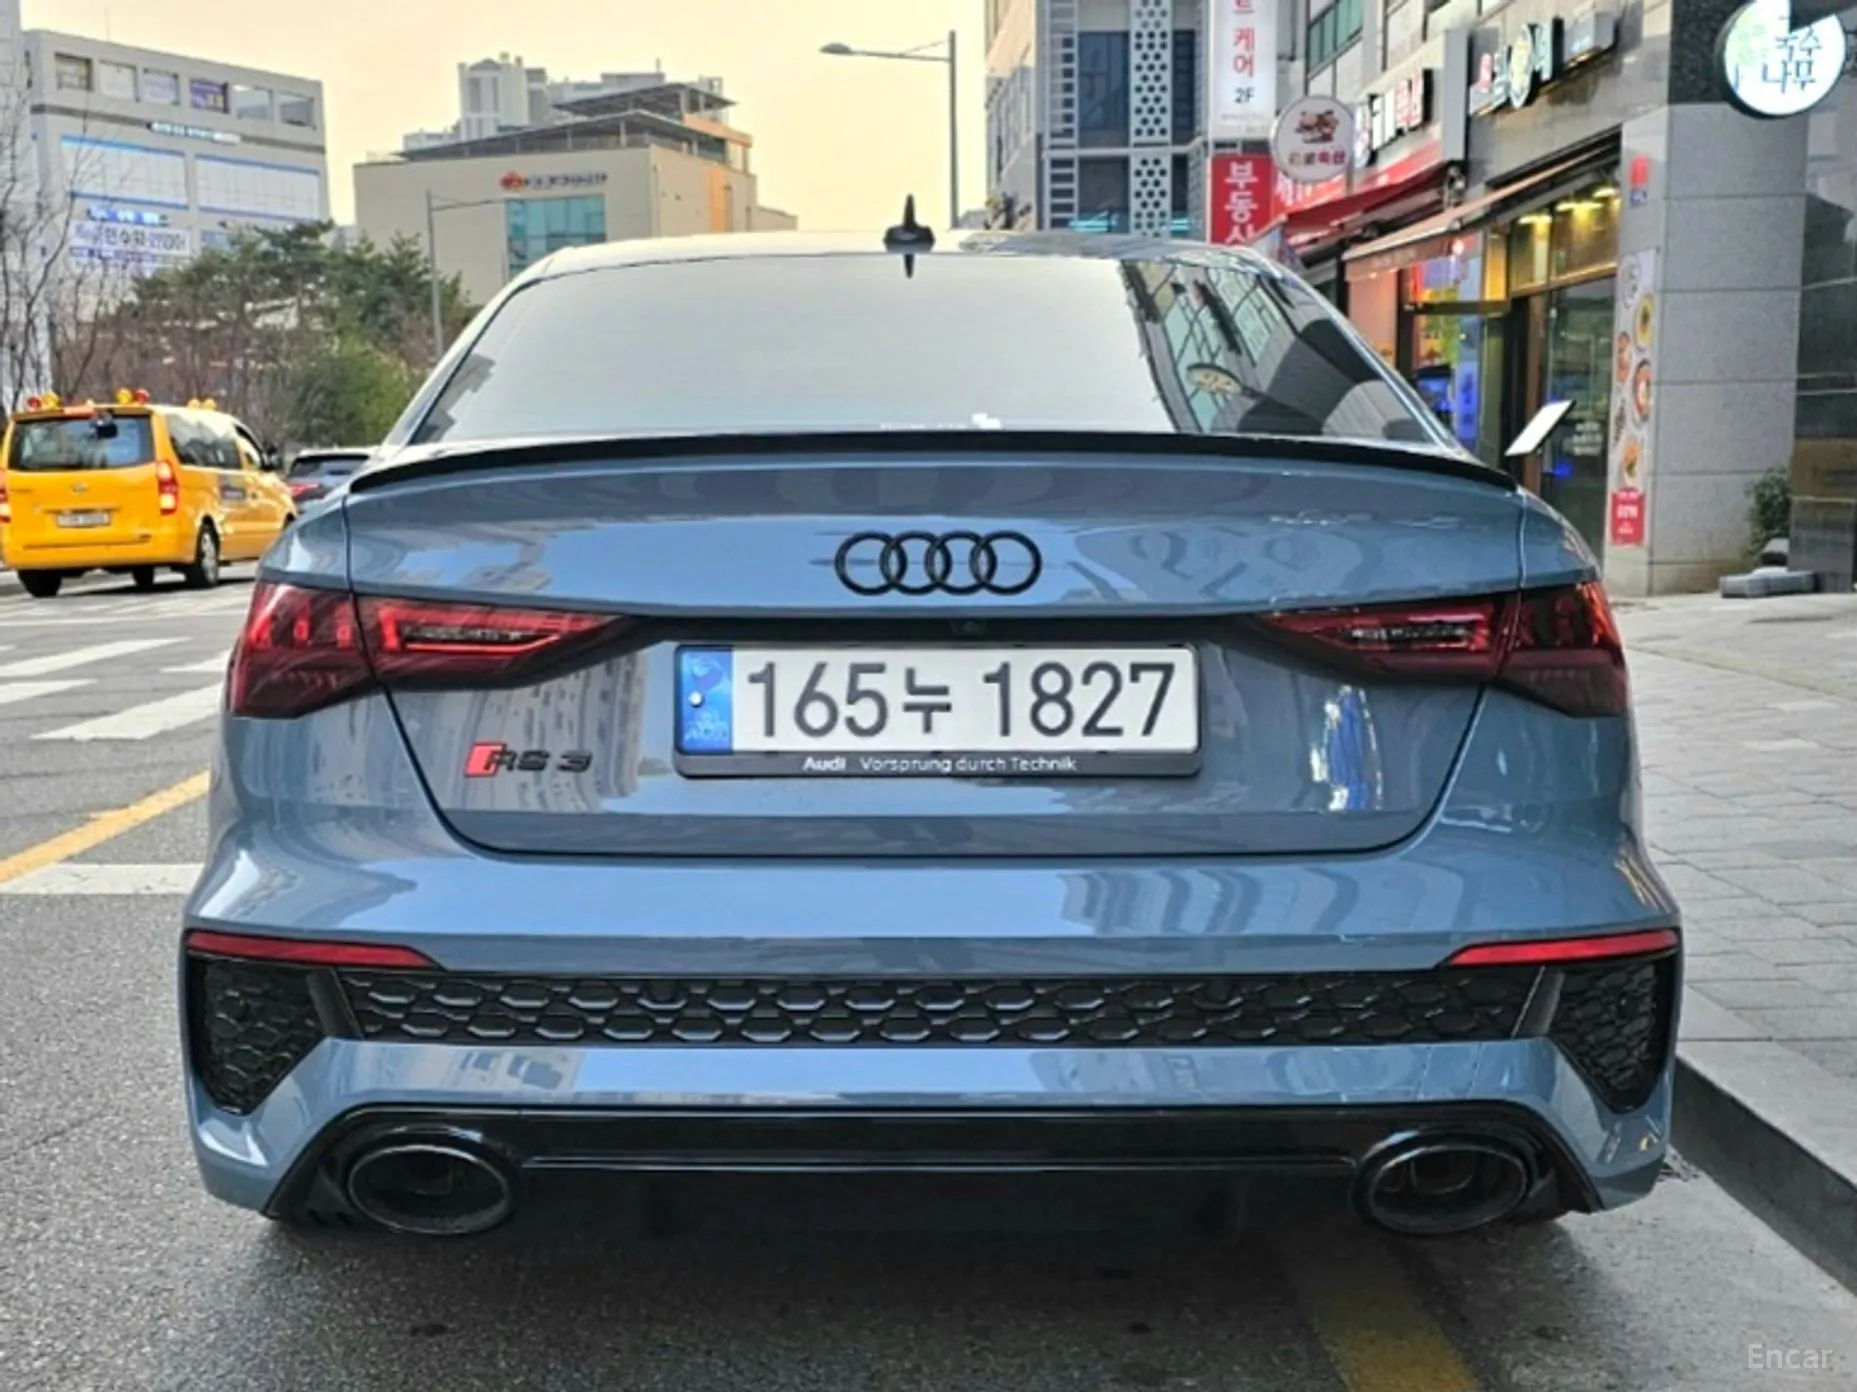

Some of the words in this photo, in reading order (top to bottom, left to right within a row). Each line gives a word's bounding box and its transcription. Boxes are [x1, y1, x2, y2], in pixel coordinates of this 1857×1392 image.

[1233, 28, 1255, 78] 케어
[1762, 59, 1816, 94] 나무
[1234, 87, 1255, 104] 2F
[747, 661, 952, 738] 165누
[982, 661, 1176, 737] 1827
[556, 750, 593, 773] 3
[803, 755, 847, 772] Audi
[860, 756, 951, 773] Vorsprung
[955, 757, 1006, 772] durch
[1010, 756, 1078, 772] Technik
